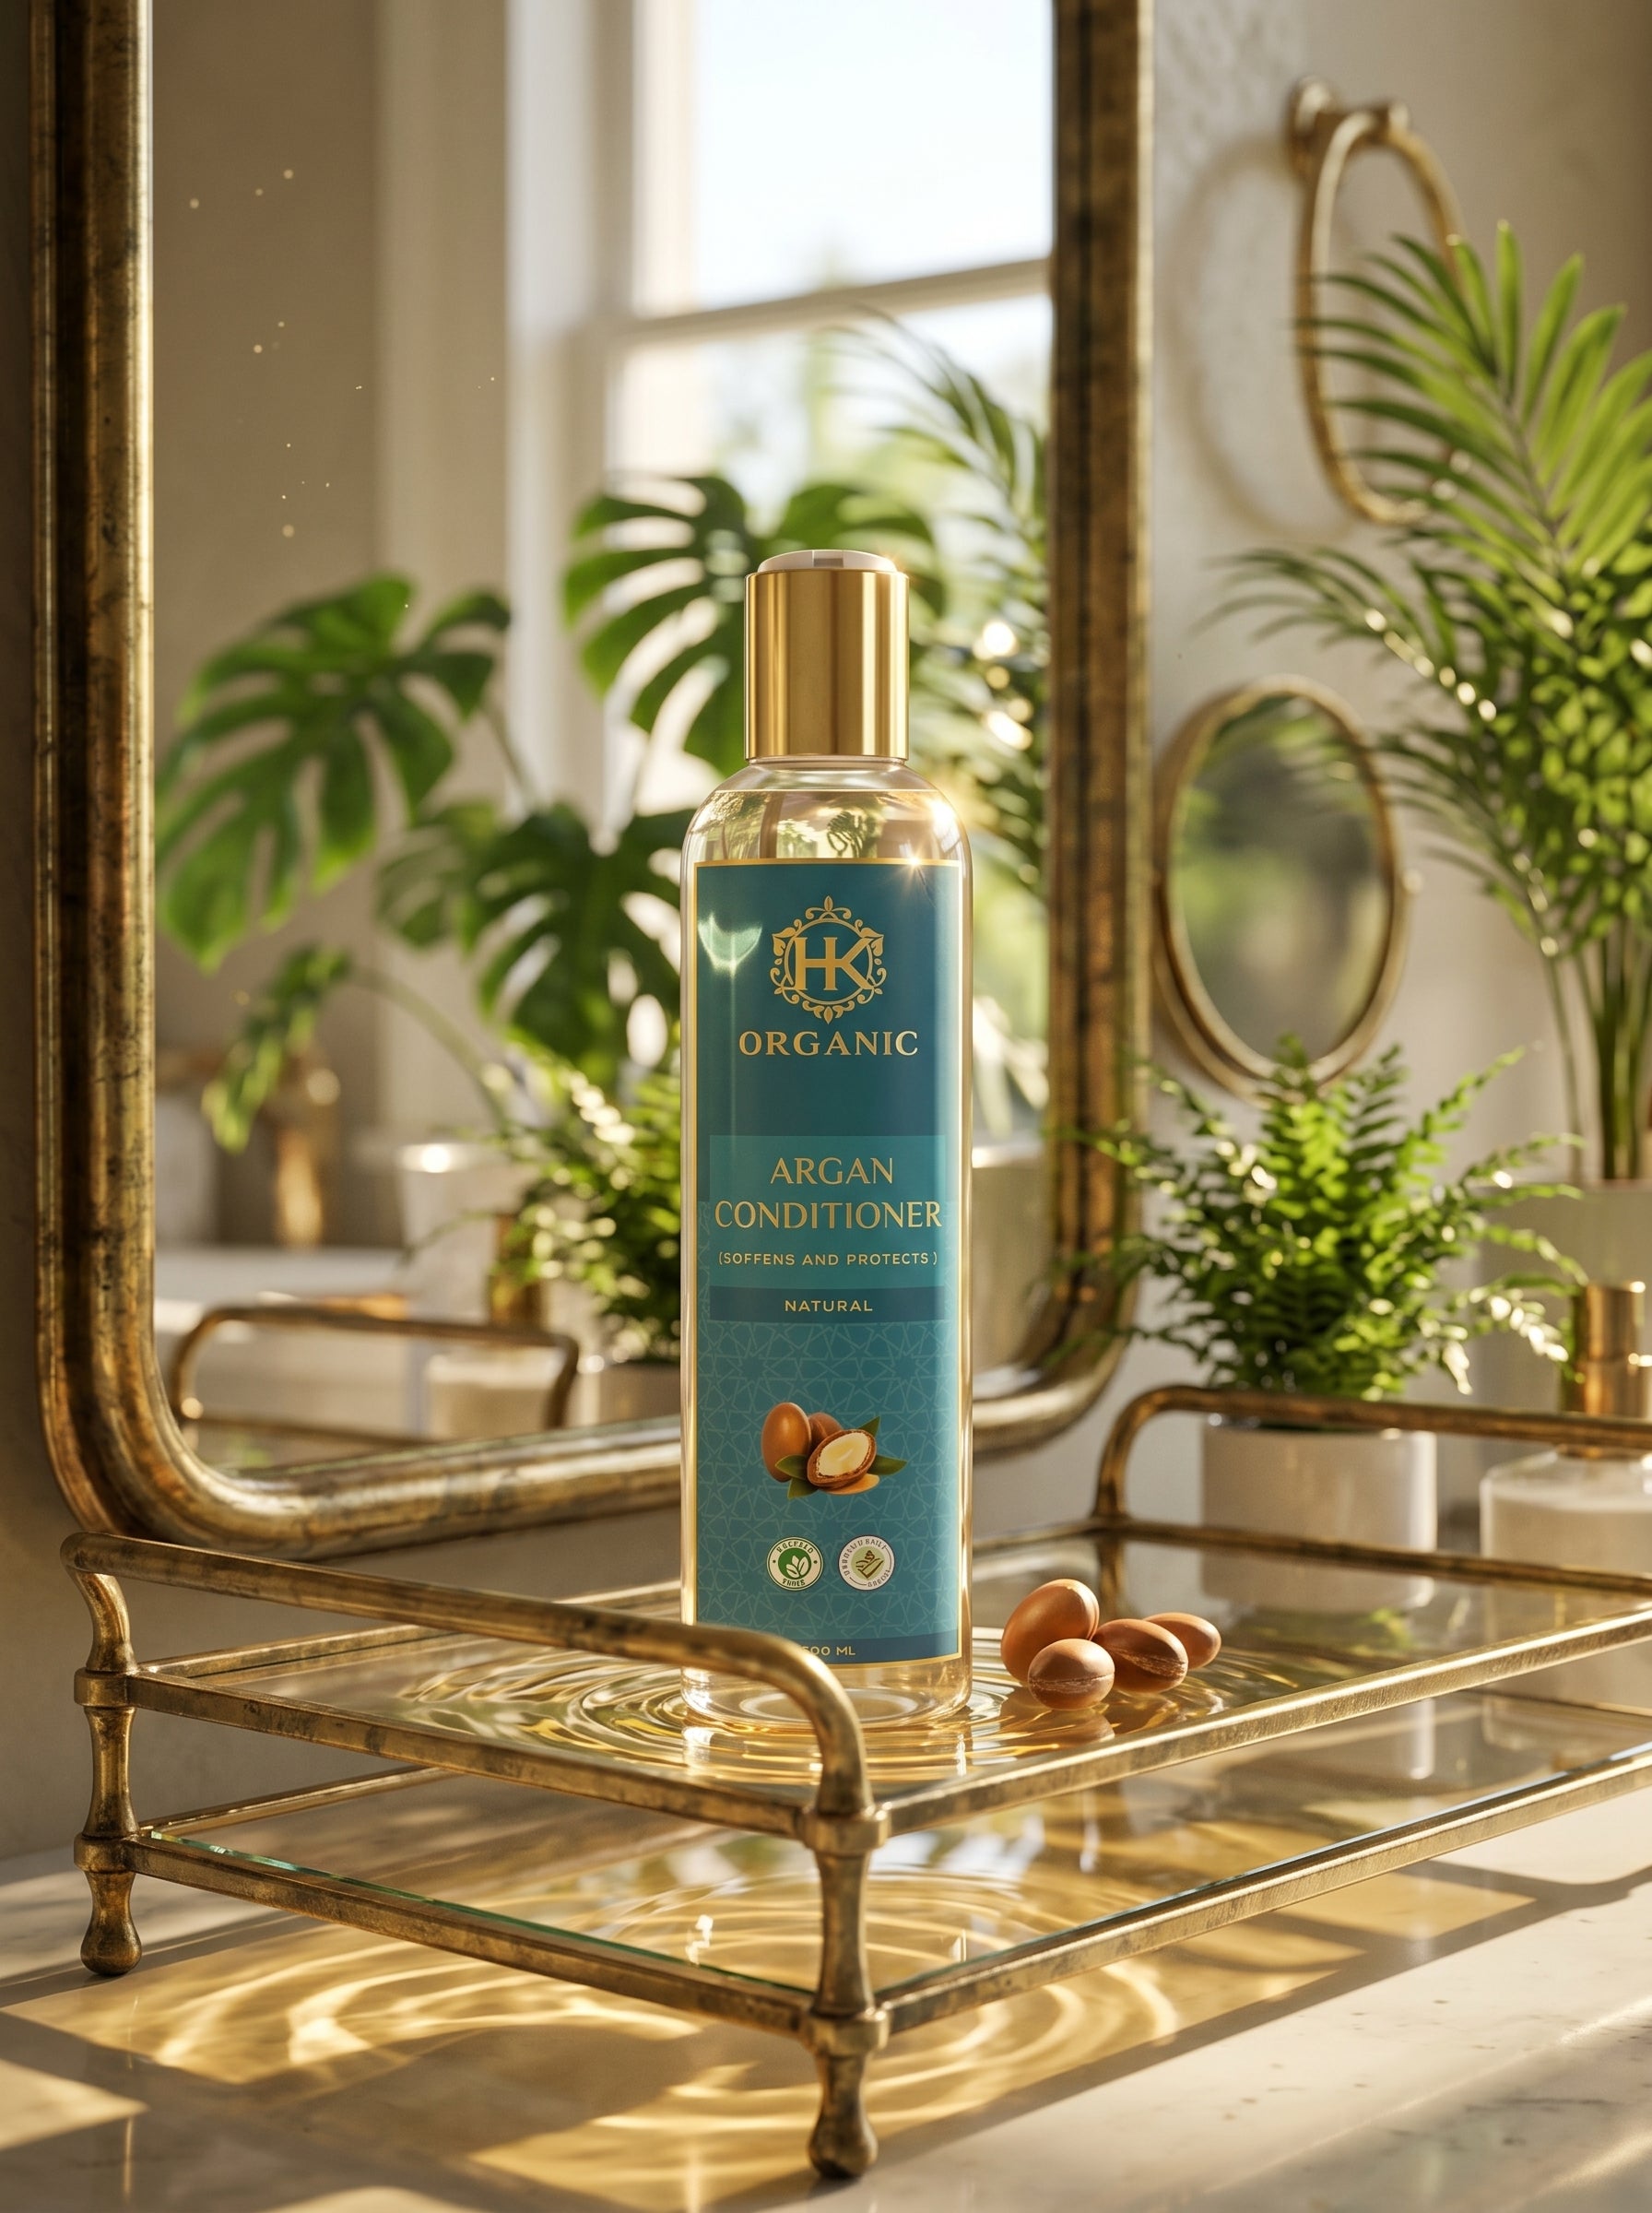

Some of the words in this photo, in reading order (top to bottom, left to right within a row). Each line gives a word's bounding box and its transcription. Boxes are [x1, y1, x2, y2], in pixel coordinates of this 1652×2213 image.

[794, 937, 873, 991] HK
[738, 1031, 918, 1056] ORGANIC
[770, 1157, 893, 1185] ARGAN
[714, 1201, 942, 1228] CONDITIONER
[718, 1251, 795, 1266] (SOFFENS
[802, 1254, 839, 1266] AND
[785, 1300, 873, 1312] NATURAL
[836, 1646, 856, 1656] ML
